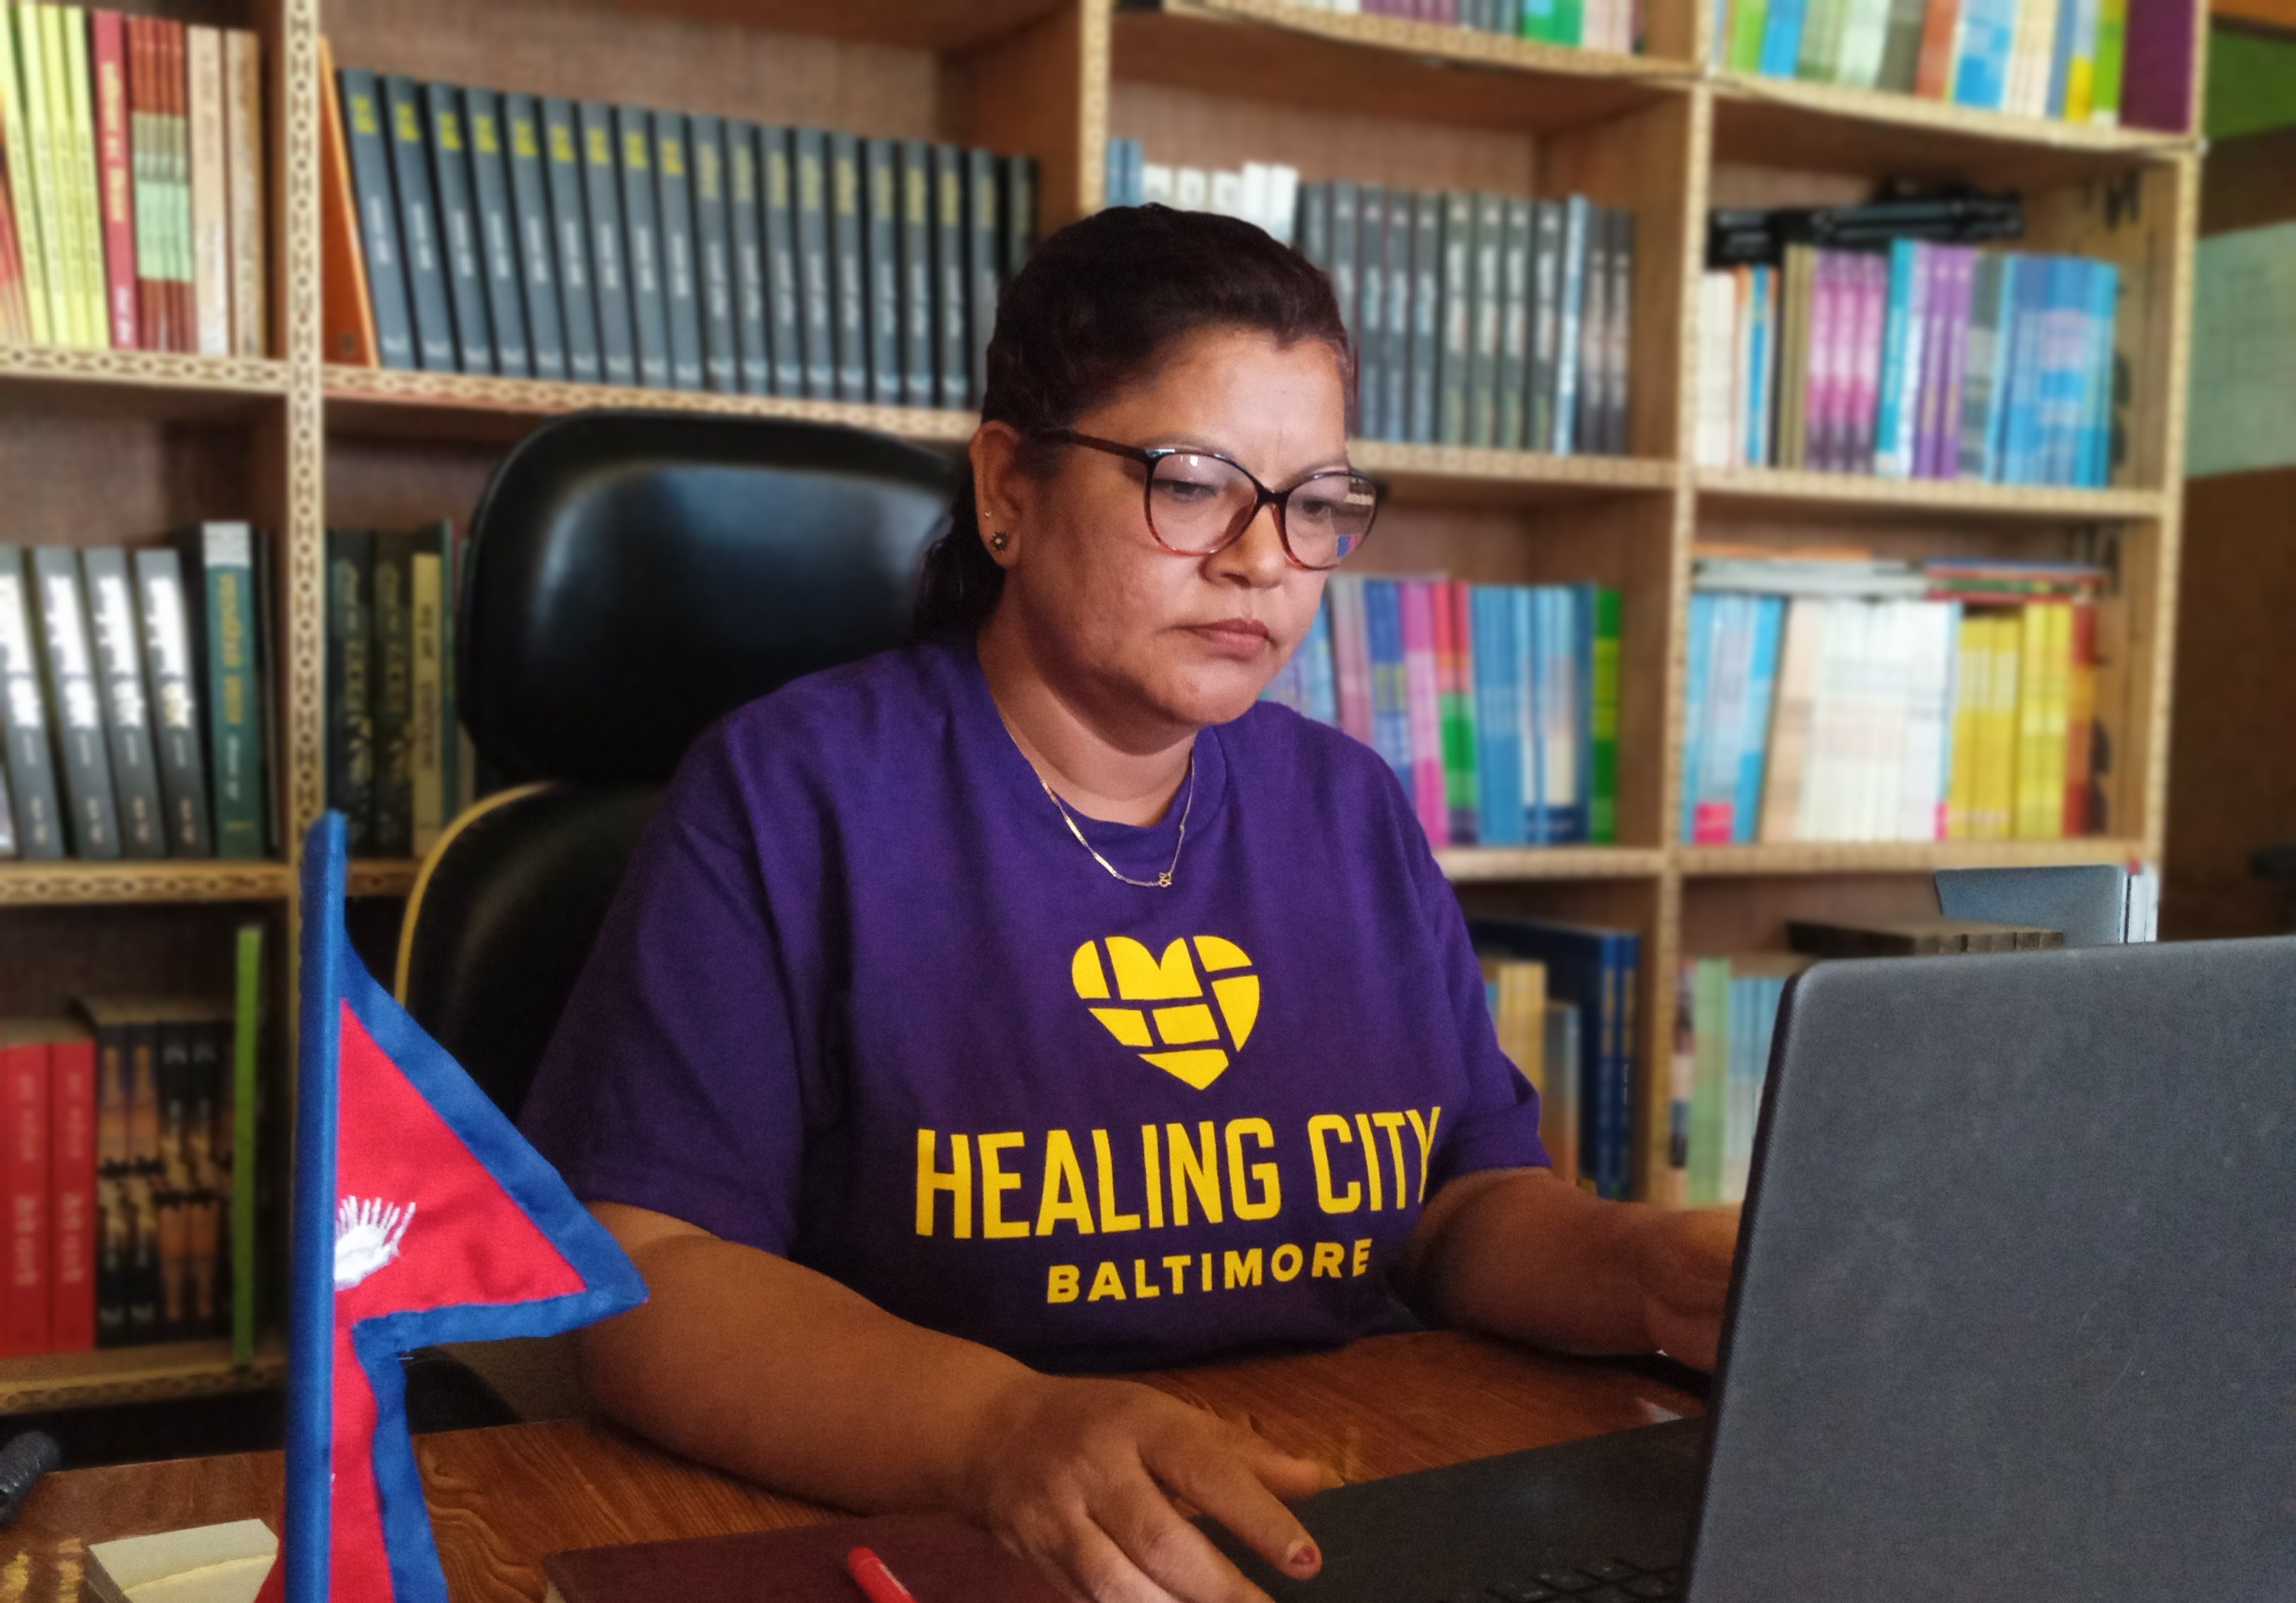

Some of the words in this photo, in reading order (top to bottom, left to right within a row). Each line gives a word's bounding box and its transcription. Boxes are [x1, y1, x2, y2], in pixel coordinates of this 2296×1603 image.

[915, 1117, 1282, 1240] HEALING
[1307, 1106, 1441, 1215] CITY
[1046, 1238, 1373, 1304] BALTIMORE
